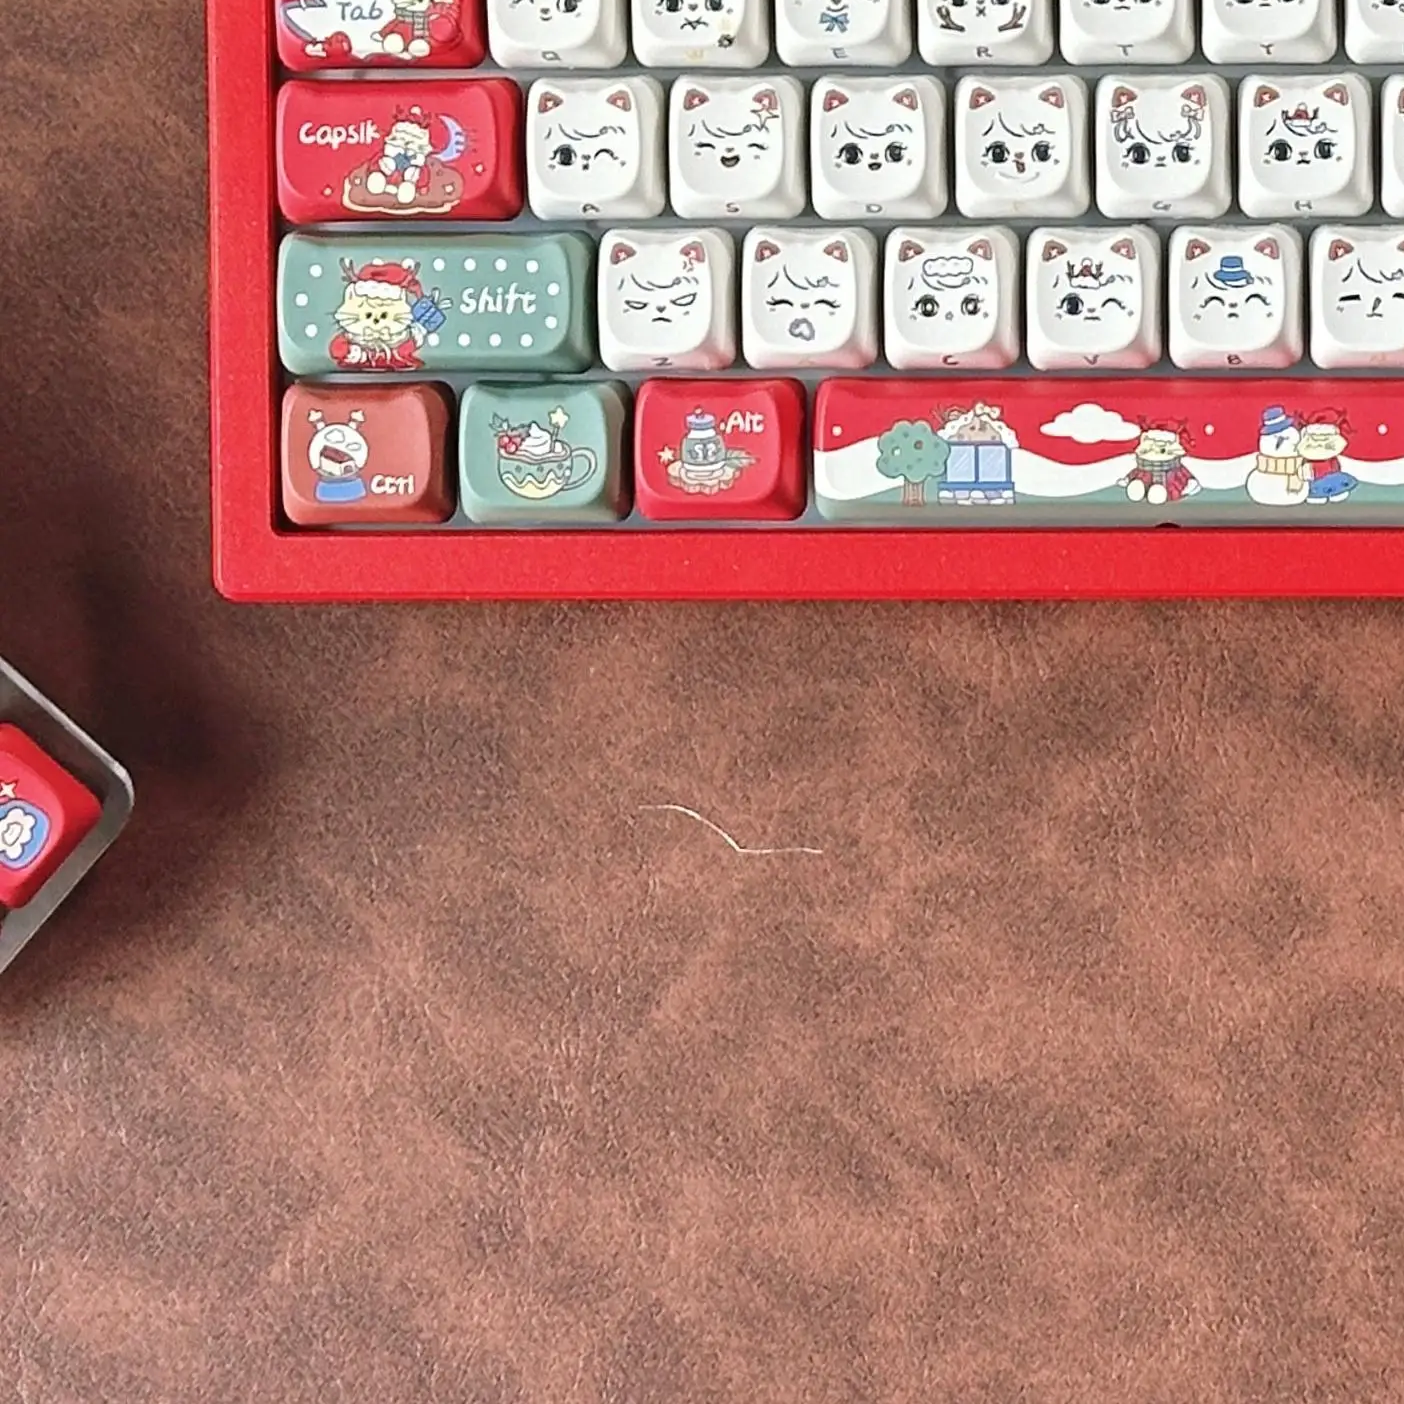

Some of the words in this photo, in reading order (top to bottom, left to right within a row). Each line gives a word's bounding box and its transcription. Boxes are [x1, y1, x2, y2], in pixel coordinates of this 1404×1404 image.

[337, 0, 384, 21] Tab
[832, 46, 848, 59] E
[976, 45, 993, 58] R
[1116, 43, 1134, 56] T
[1260, 42, 1275, 56] Y
[581, 202, 600, 215] A
[726, 202, 740, 213] S
[866, 203, 883, 214] D
[1294, 199, 1313, 211] H
[459, 282, 536, 314] Shift
[652, 356, 673, 367] Z
[942, 354, 958, 366] C
[1083, 354, 1101, 366] V
[1226, 353, 1243, 365] B
[725, 410, 764, 434] Alt
